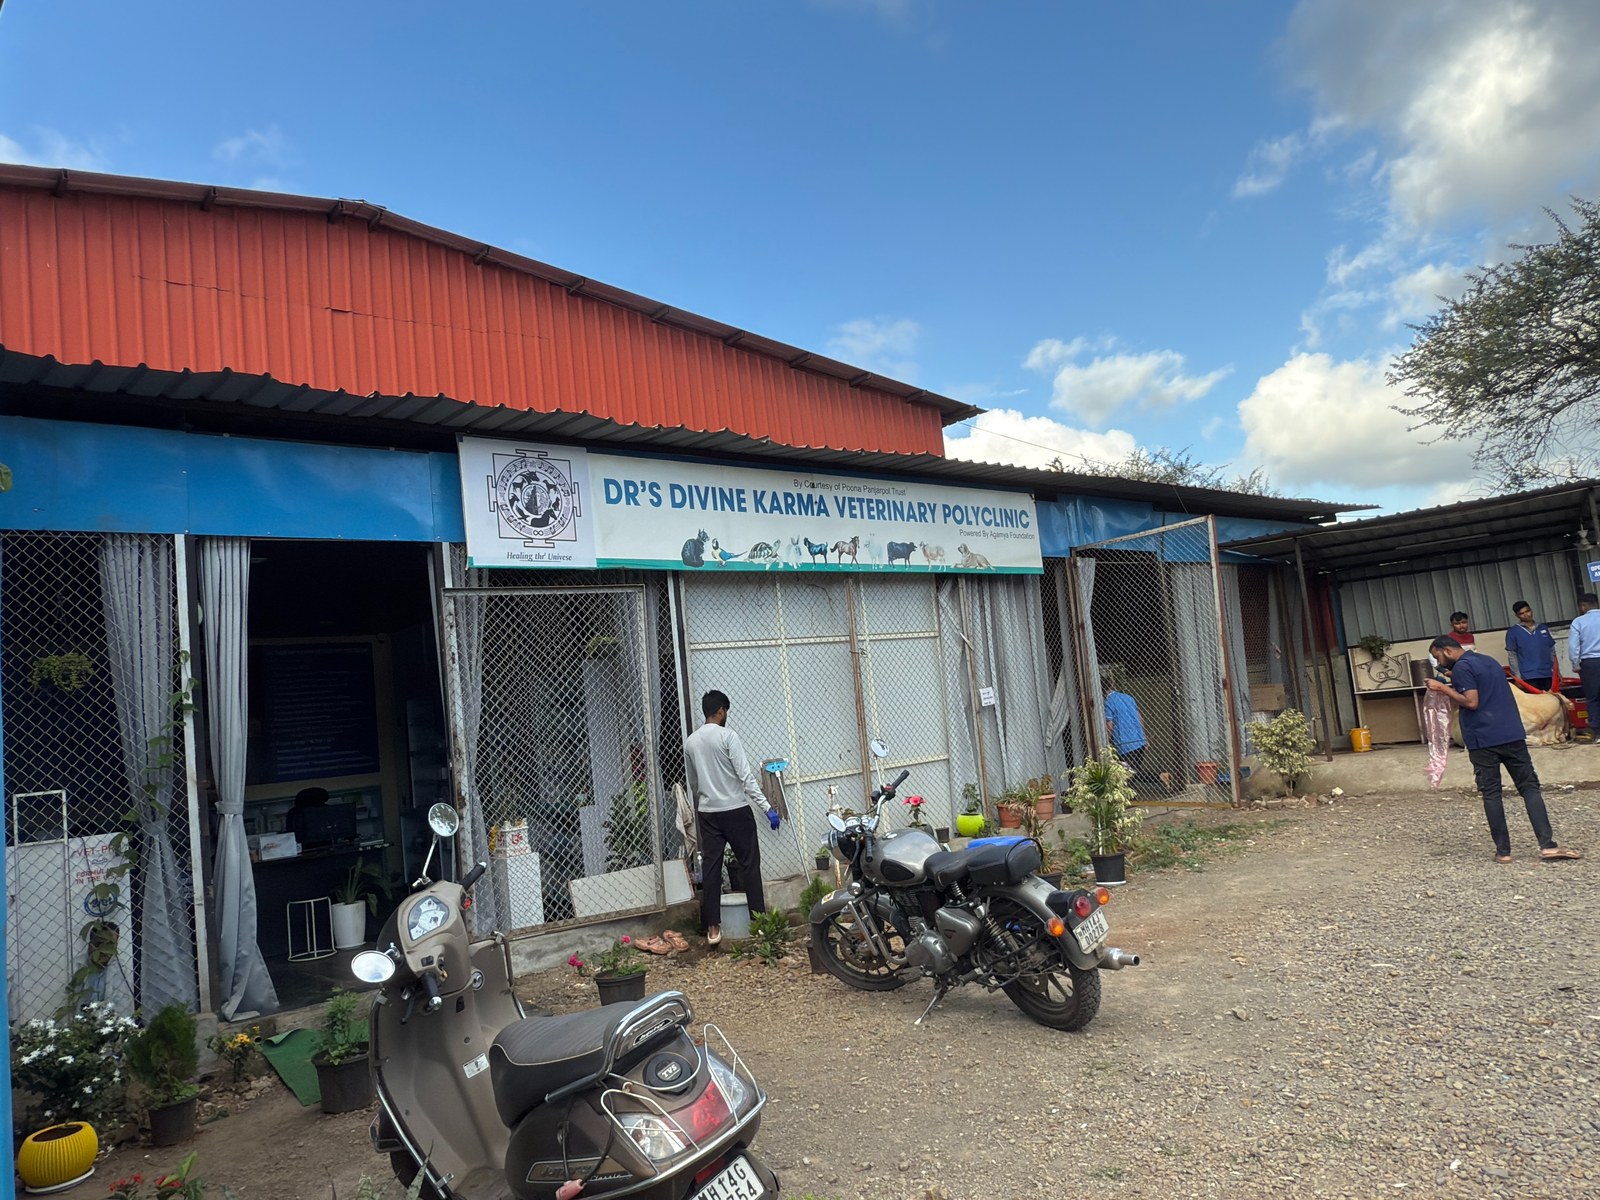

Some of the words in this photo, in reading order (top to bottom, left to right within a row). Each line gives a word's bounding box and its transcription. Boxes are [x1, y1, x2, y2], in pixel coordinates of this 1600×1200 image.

[793, 479, 803, 489] By
[804, 480, 833, 492] Courtesy
[834, 482, 841, 491] of
[842, 483, 862, 493] Poona
[863, 485, 891, 496] Panjarpol
[892, 487, 906, 496] Trust
[603, 478, 662, 508] DR'S
[669, 483, 747, 513] DIVINE
[752, 489, 830, 518] KARMA
[834, 495, 937, 524] VETERINARY
[942, 503, 1030, 529] POLYCLINIC
[960, 529, 982, 538] Powered
[982, 530, 989, 539] By
[1010, 531, 1035, 540] Foundation
[506, 552, 534, 561] Healing
[547, 553, 573, 561] Univese
[76, 868, 107, 878] FORMUL
[661, 1063, 678, 1078] TVS
